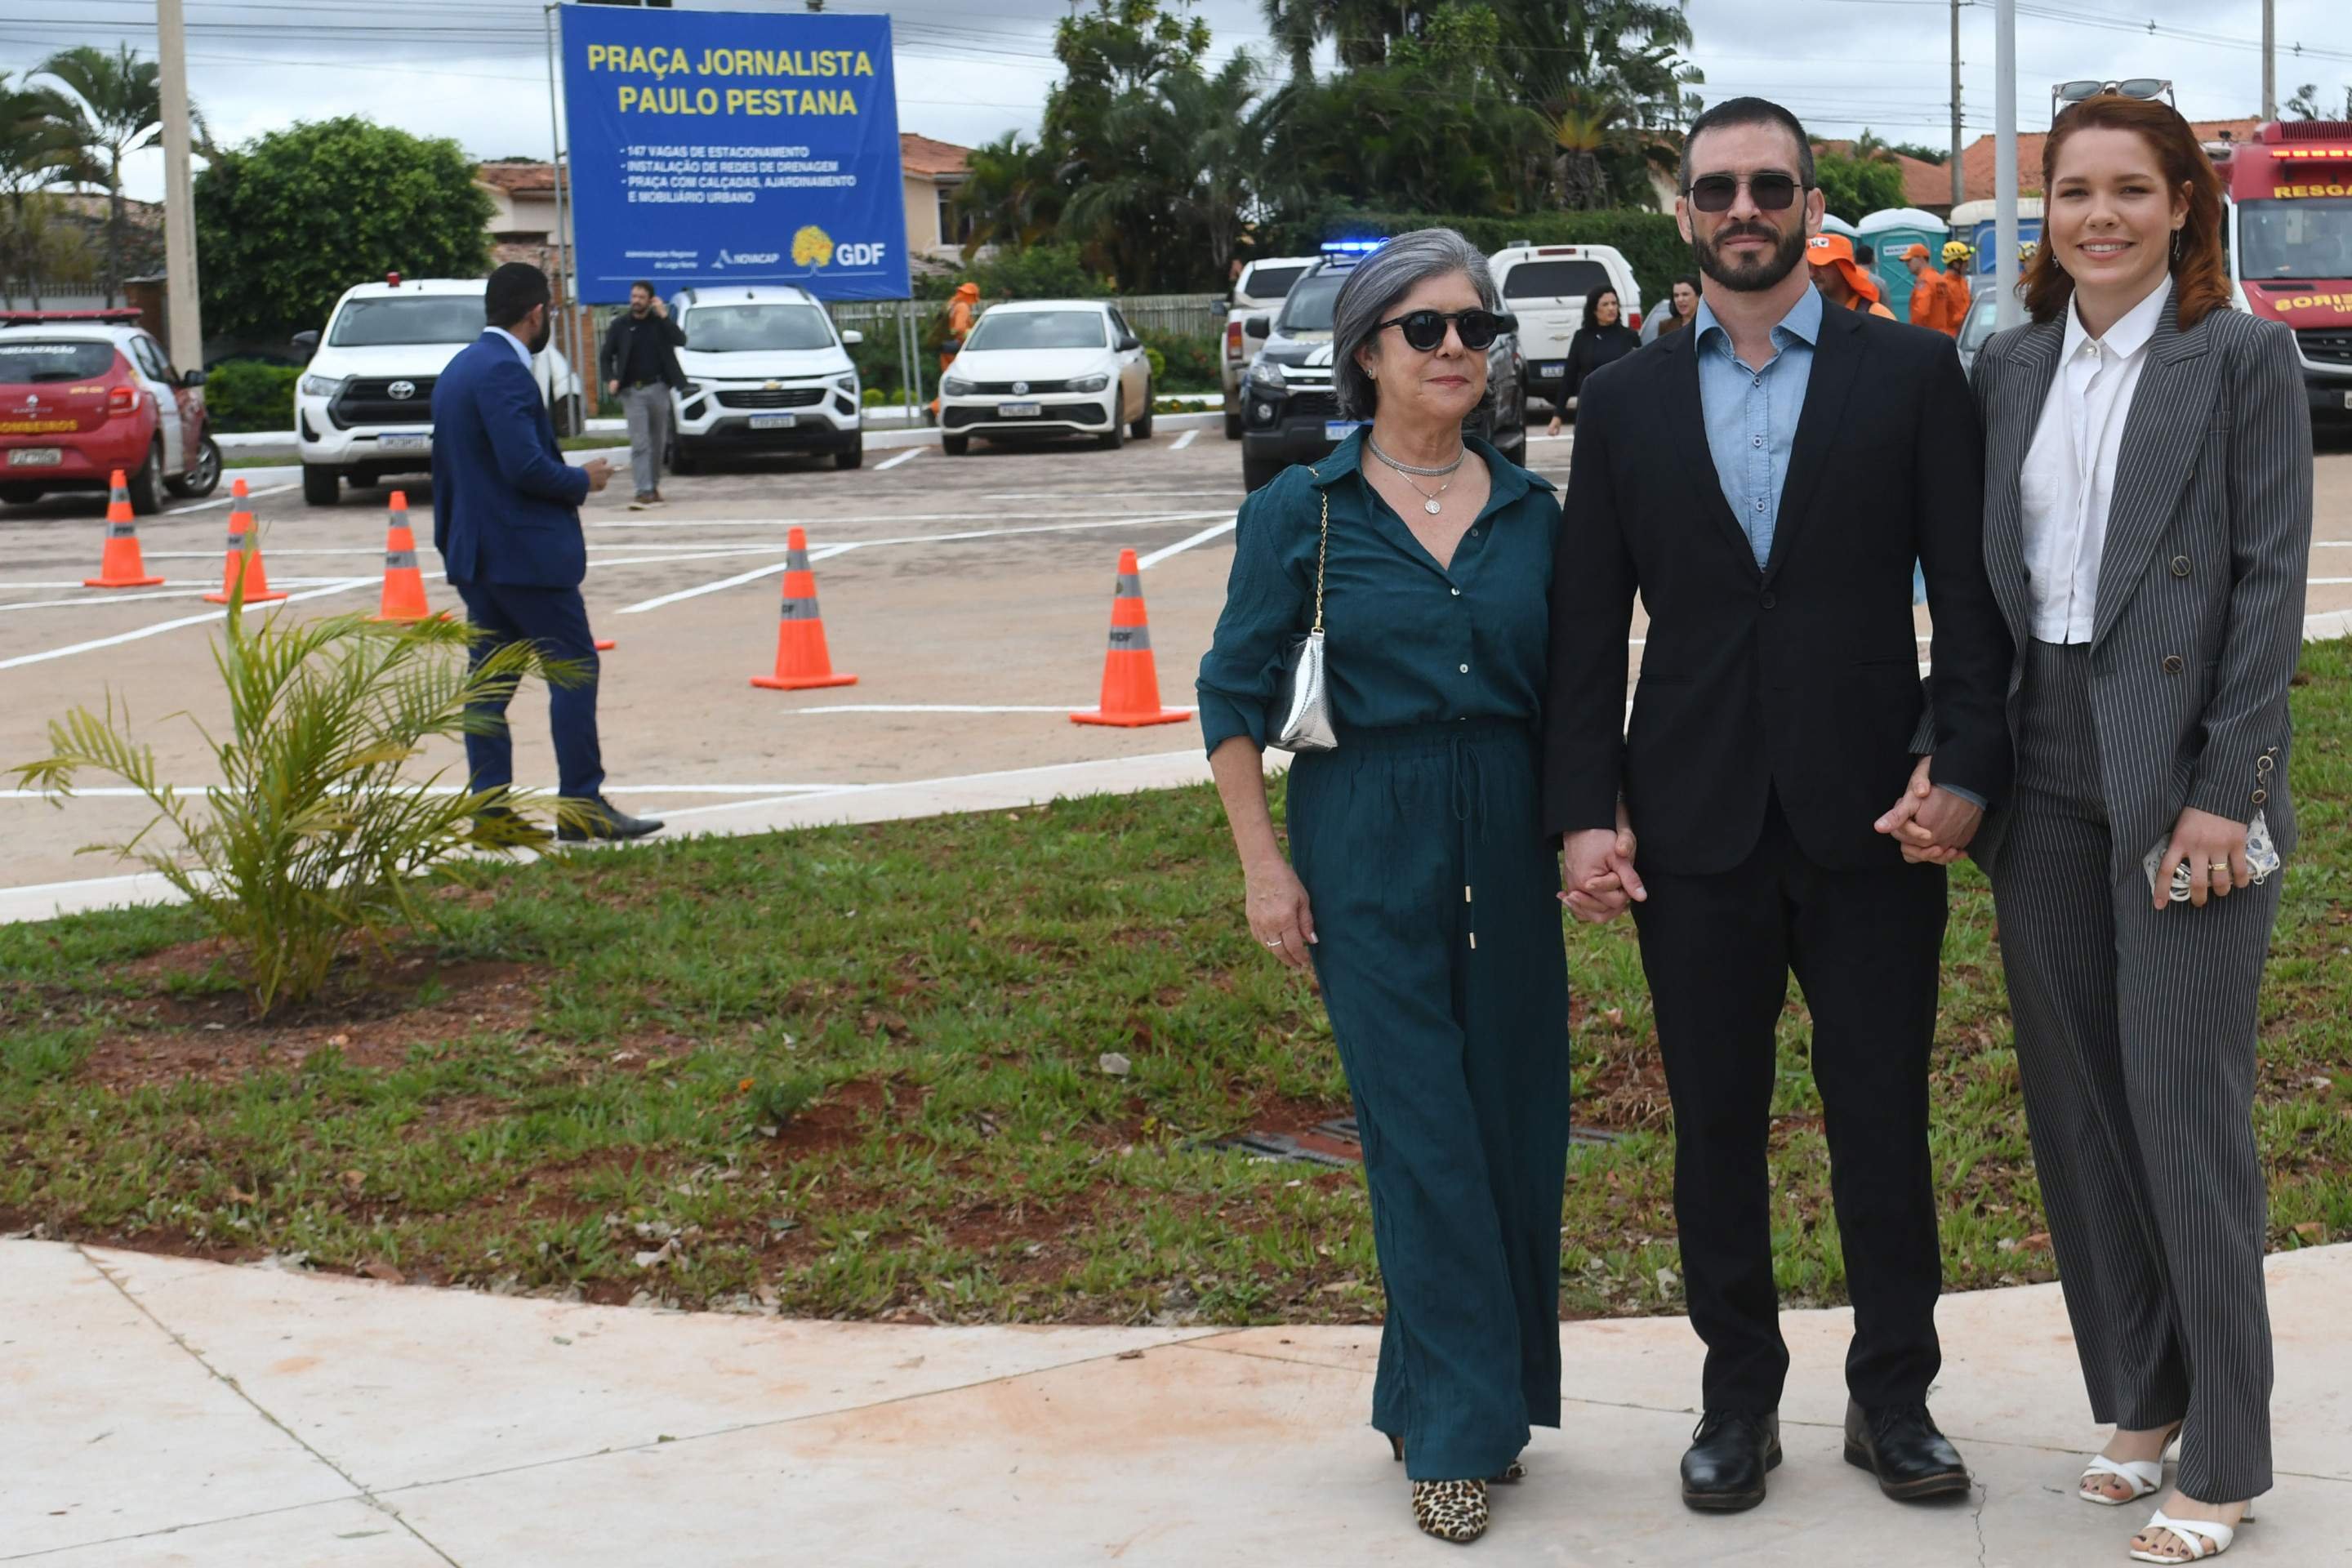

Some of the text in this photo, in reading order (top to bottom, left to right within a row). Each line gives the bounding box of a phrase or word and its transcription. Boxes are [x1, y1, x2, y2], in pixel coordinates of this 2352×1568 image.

[587, 44, 874, 80] PRAÇA JORNALISTA
[618, 87, 858, 115] PAULO PESTANA
[627, 145, 810, 158] 147 VAGAS DE ESTACIONAMENTO
[627, 159, 839, 175] INSTALAÇÃO DE REDES DE DRENAGEM
[628, 176, 668, 190] PRAÇA
[670, 176, 697, 188] COM
[764, 176, 857, 188] AJARDINAMENTO
[628, 189, 756, 203] E MOBILIÁRIO URBANO
[836, 243, 885, 265] GDF
